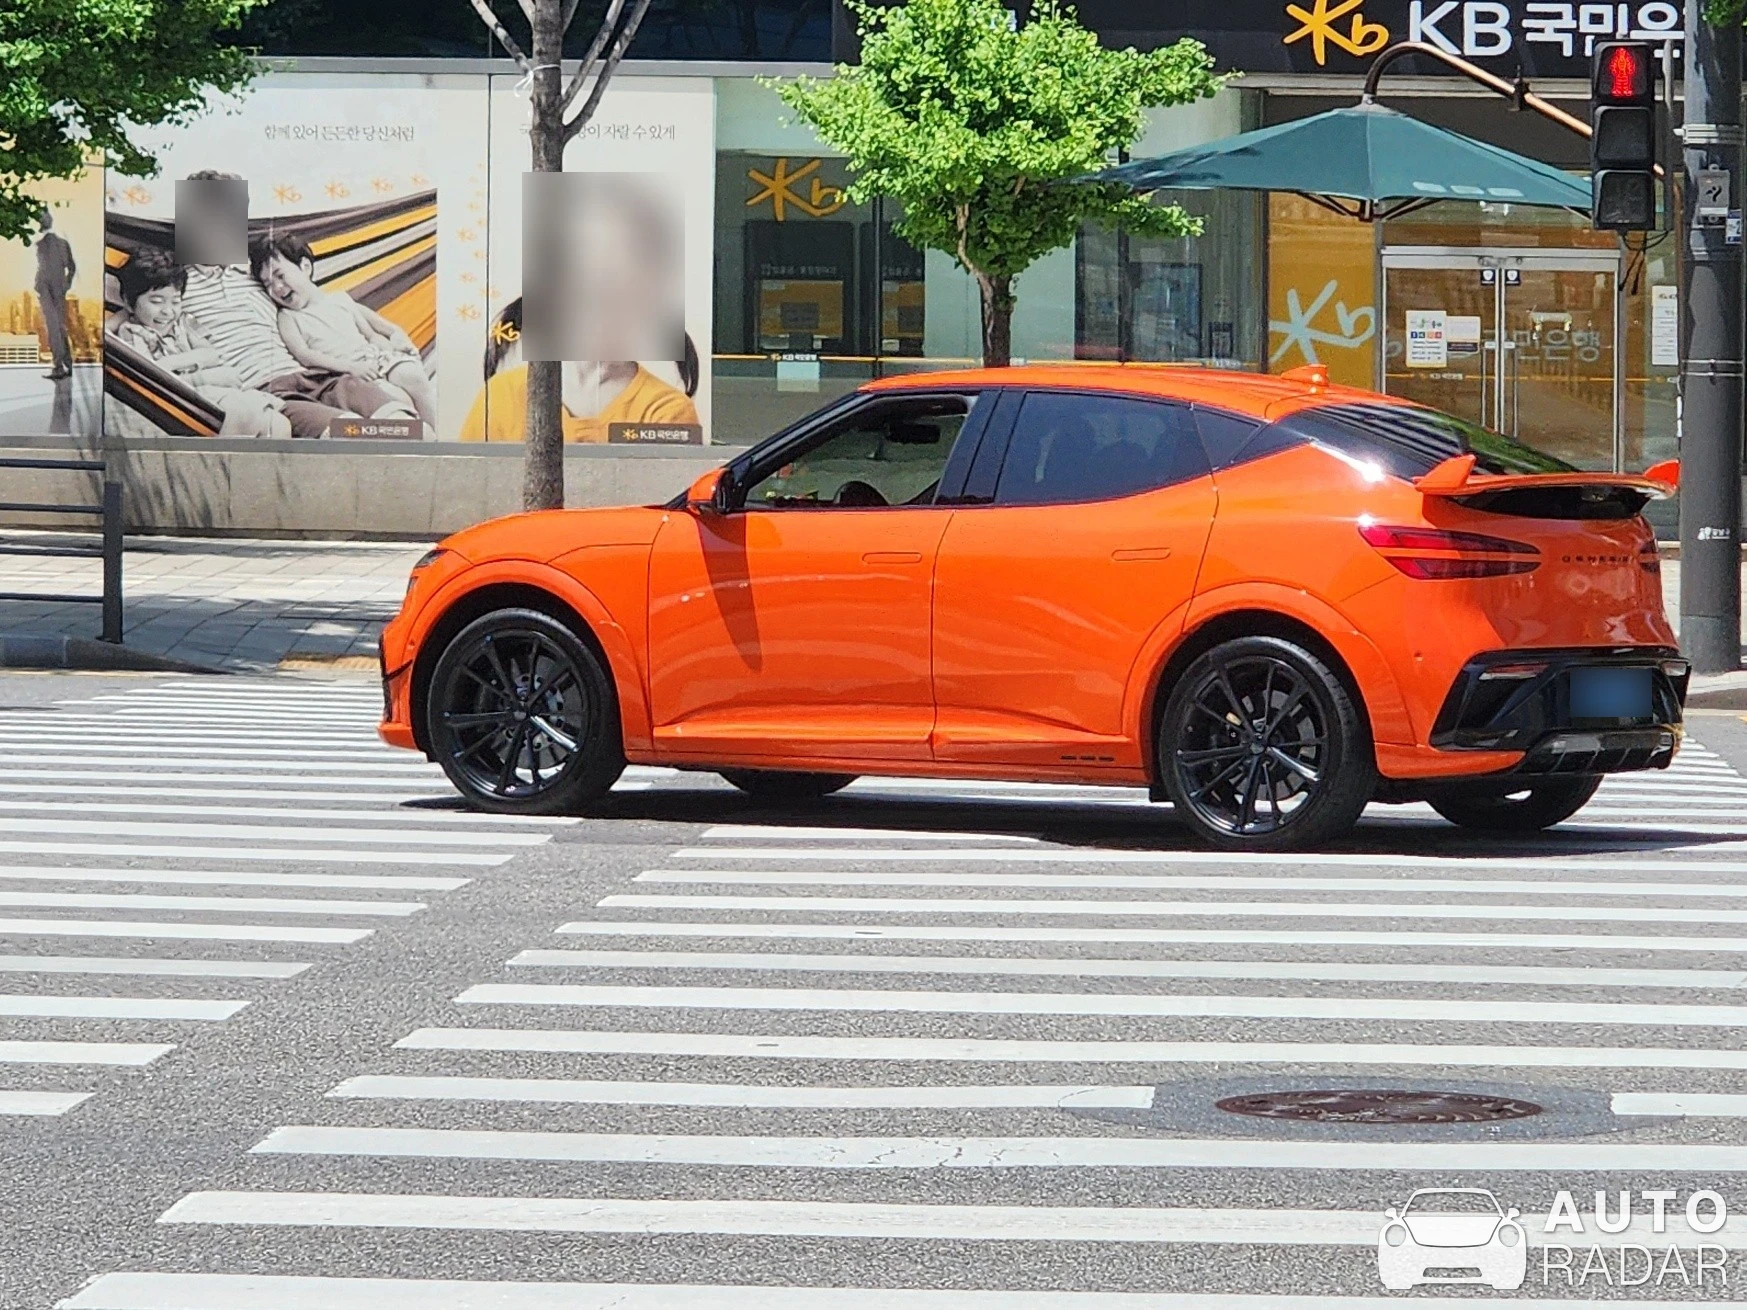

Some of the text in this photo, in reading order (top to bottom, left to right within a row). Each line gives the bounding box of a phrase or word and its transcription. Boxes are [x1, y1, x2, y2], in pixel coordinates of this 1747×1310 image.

[1409, 1, 1511, 57] KB
[264, 124, 415, 141] 함께 있어 든든한 당신처럼
[605, 124, 630, 140] 자랄
[632, 125, 648, 140] 수
[649, 124, 675, 140] 있게
[361, 426, 377, 435] KB
[640, 430, 656, 440] KB
